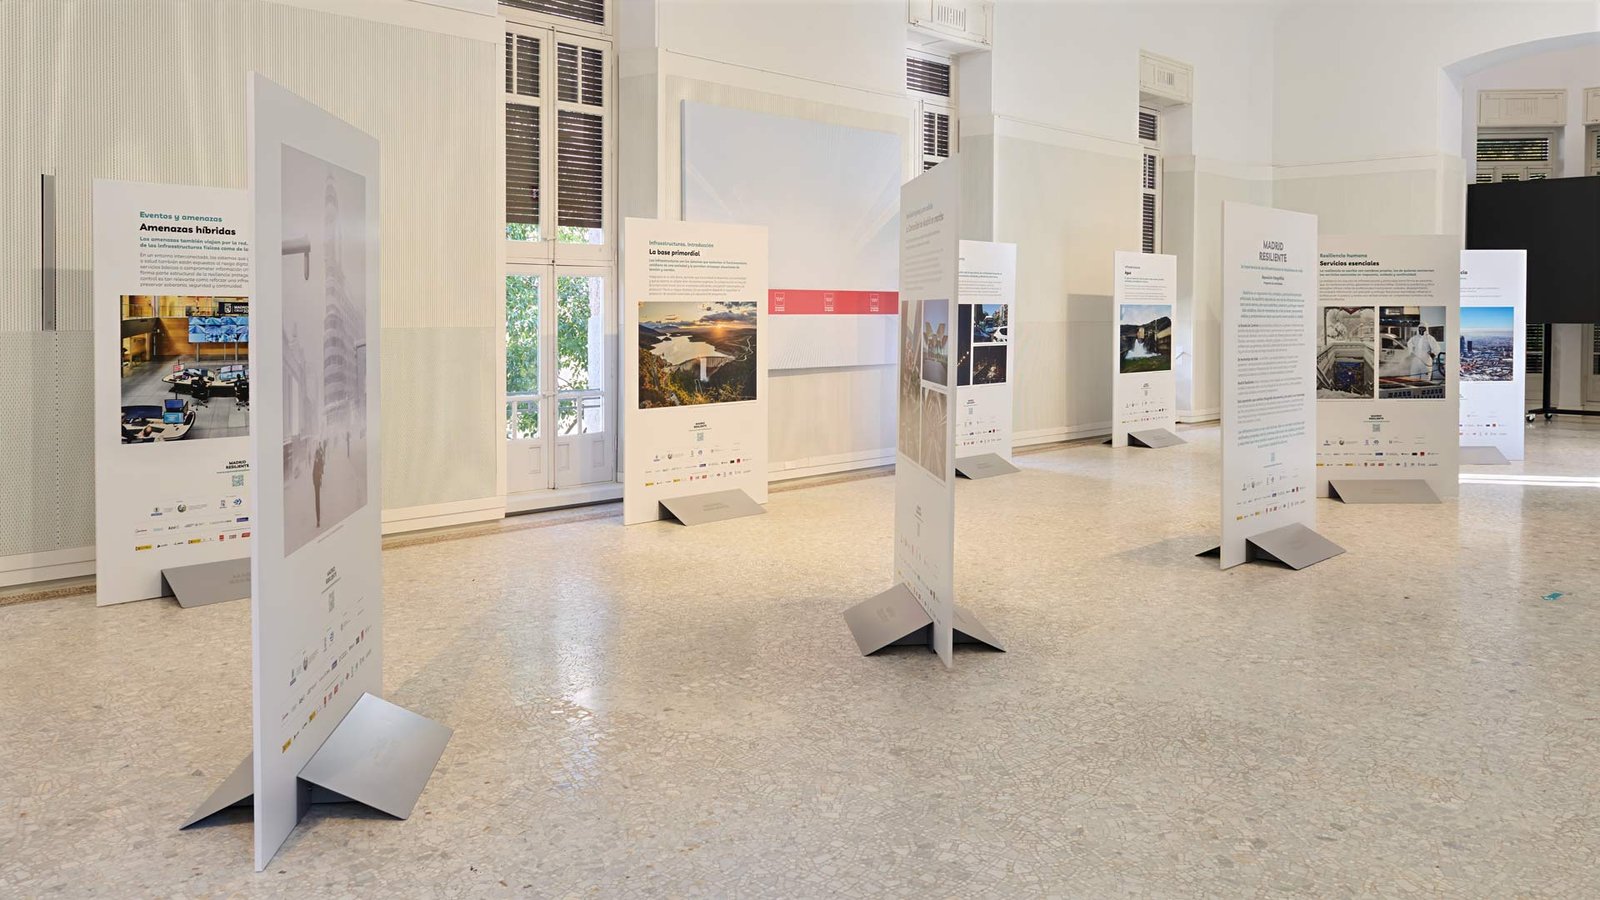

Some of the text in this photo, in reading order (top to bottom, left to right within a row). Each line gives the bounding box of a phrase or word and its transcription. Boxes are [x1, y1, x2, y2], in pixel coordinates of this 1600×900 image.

[140, 211, 172, 219] Eventos
[139, 223, 236, 235] Amenazas híbridas
[1263, 240, 1285, 251] MADRID
[657, 248, 670, 256] base
[671, 249, 700, 257] primordial
[1259, 251, 1287, 263] RESILIENTE
